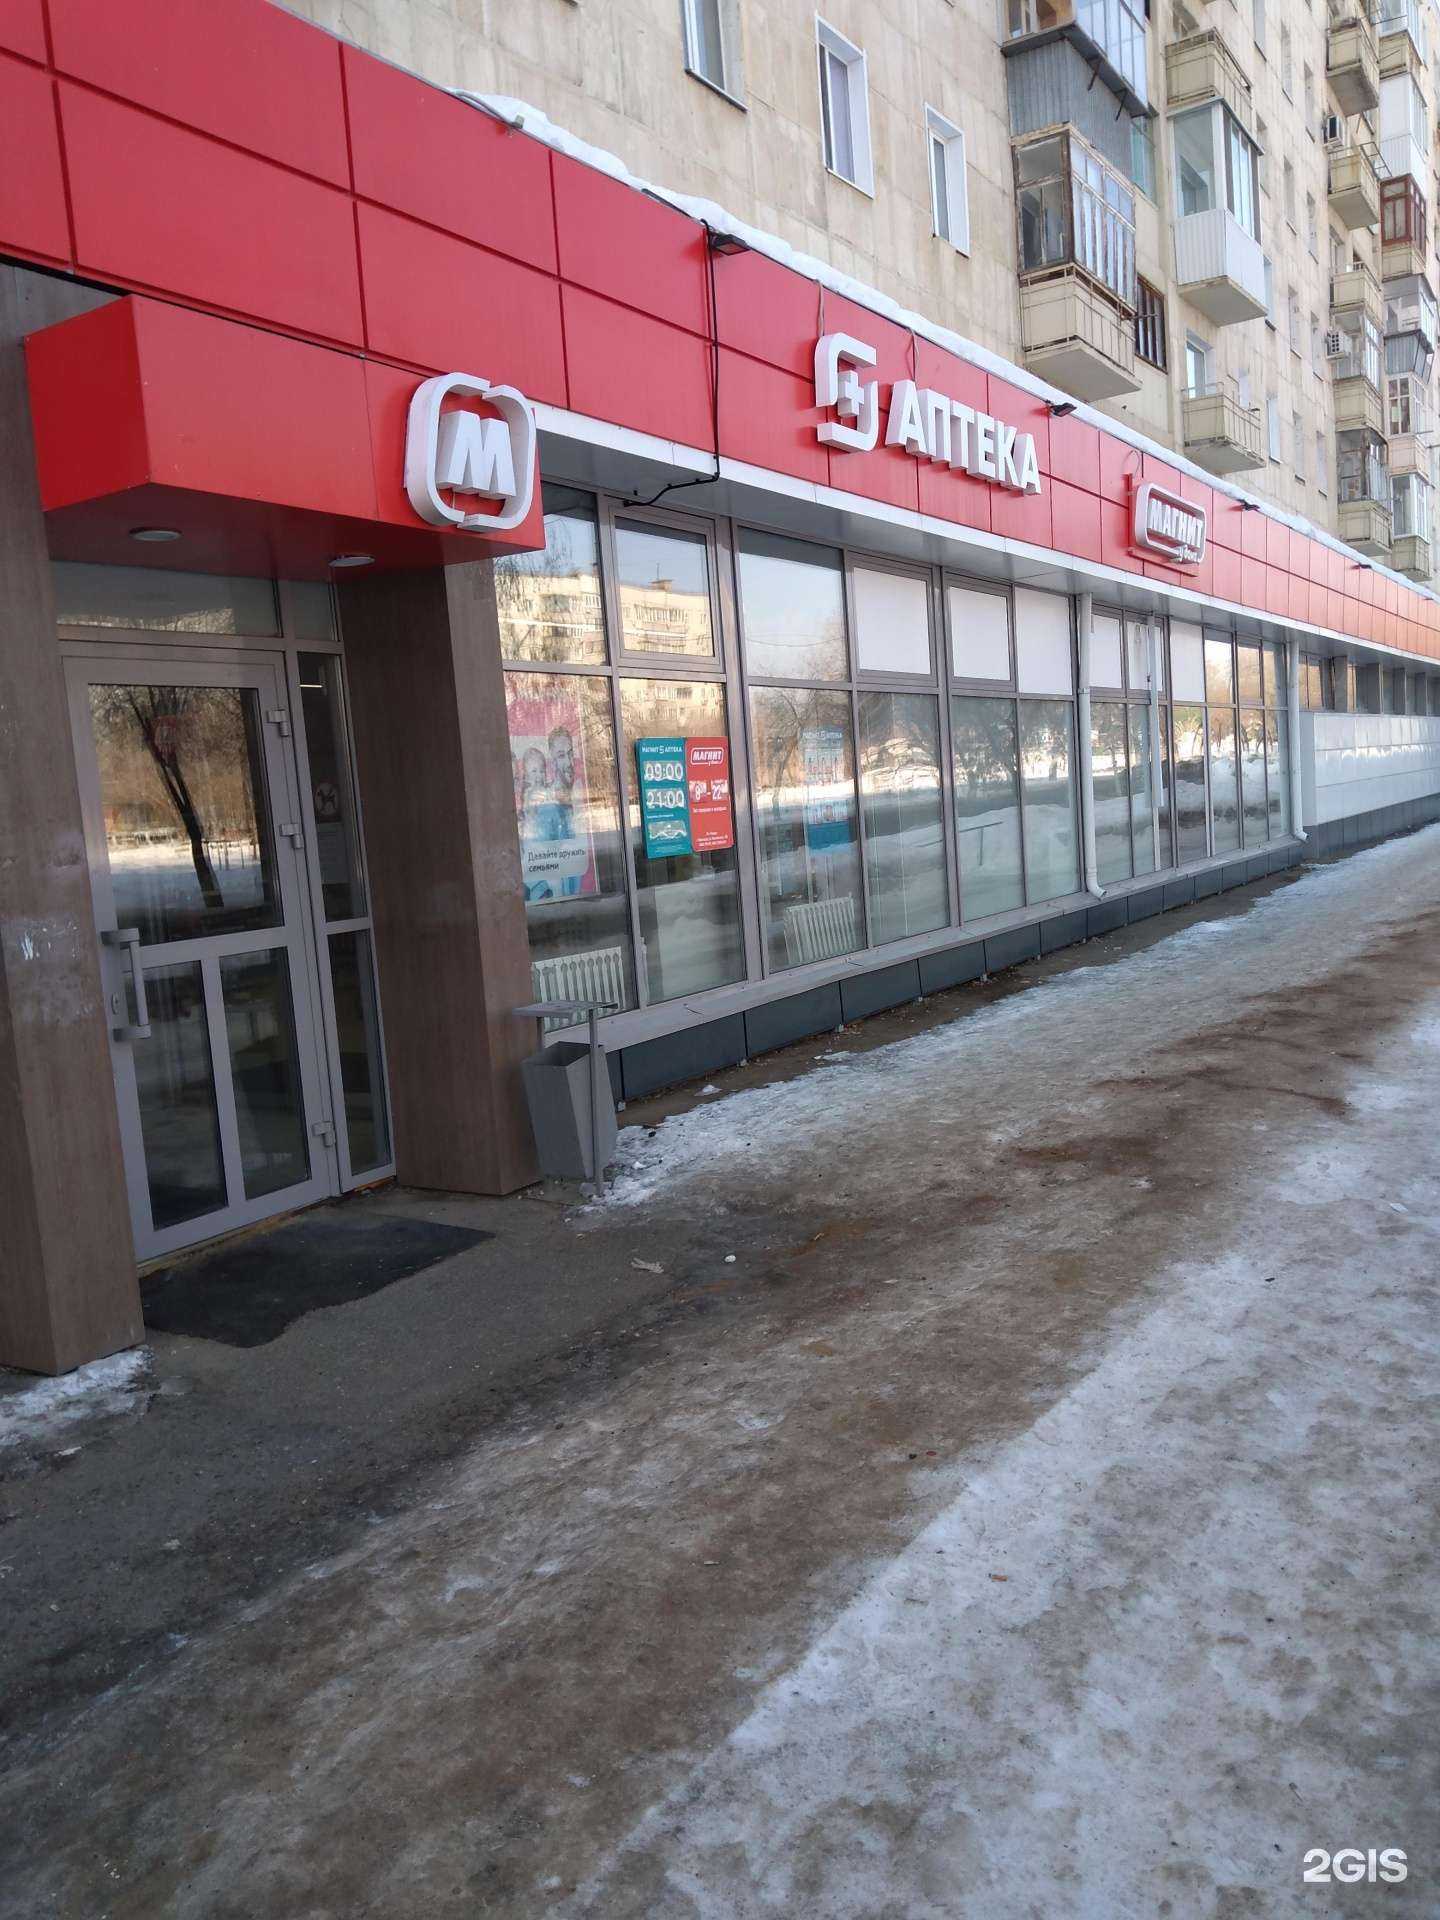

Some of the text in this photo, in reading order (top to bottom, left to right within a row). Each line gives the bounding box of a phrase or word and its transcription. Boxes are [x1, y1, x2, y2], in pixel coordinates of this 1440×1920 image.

[885, 379, 1041, 495] АПТЕКА
[437, 410, 516, 499] М
[1148, 498, 1204, 549] МАГНИТ
[692, 750, 722, 761] МАГНИТ
[645, 762, 684, 780] 09:00
[646, 790, 685, 808] 21:00
[528, 848, 586, 861] Давайте дружить
[528, 863, 560, 873] семьями
